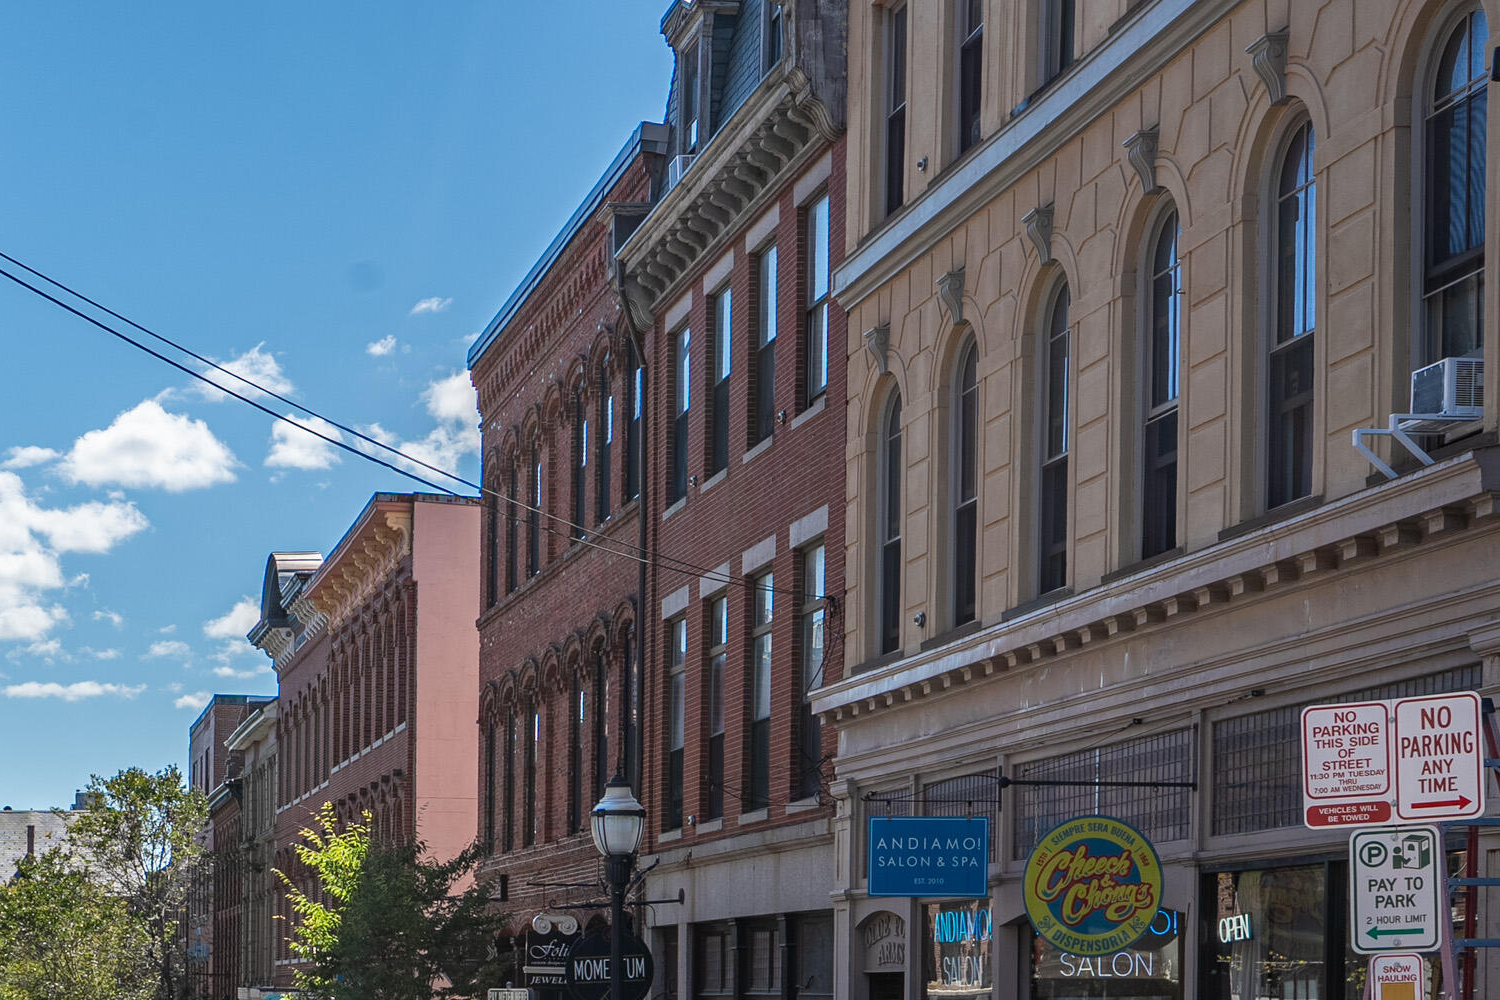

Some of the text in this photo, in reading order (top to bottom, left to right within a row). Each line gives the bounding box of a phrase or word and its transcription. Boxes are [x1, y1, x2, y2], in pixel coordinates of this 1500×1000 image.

[1334, 711, 1356, 724] NO
[1421, 706, 1452, 730] NO
[1313, 722, 1380, 738] PARKING
[1314, 736, 1379, 750] THIS SIDE
[1402, 731, 1474, 758] PARKING
[1338, 748, 1356, 758] OF
[1322, 758, 1372, 772] STREET
[1421, 758, 1454, 776] ANY
[1348, 769, 1386, 778] TUESDAY
[1342, 784, 1382, 792] WEDNESDAY
[1418, 776, 1458, 794] TIME
[1318, 806, 1357, 815] VEHICLES
[1342, 814, 1370, 822] TOWED
[1052, 822, 1136, 846] SIEMPRE SERA BUENA
[877, 838, 980, 850] ANDIAMO!
[878, 856, 978, 867] SALON & SPA
[1036, 844, 1132, 901] Cheech
[1100, 874, 1114, 888] &
[1368, 876, 1424, 892] PAY TO
[1062, 878, 1154, 926] Chong's
[1375, 894, 1416, 908] PARK
[934, 908, 994, 943] ANDIAMO!
[1366, 914, 1427, 924] 2 HOUR LIMIT
[1219, 913, 1252, 944] OPEN
[574, 957, 645, 980] MOMEUM
[943, 955, 983, 987] SALON
[1060, 952, 1153, 977] SALON
[1382, 965, 1412, 974] SNOW
[530, 976, 568, 984] JEWEL
[1378, 974, 1417, 982] HAULING
